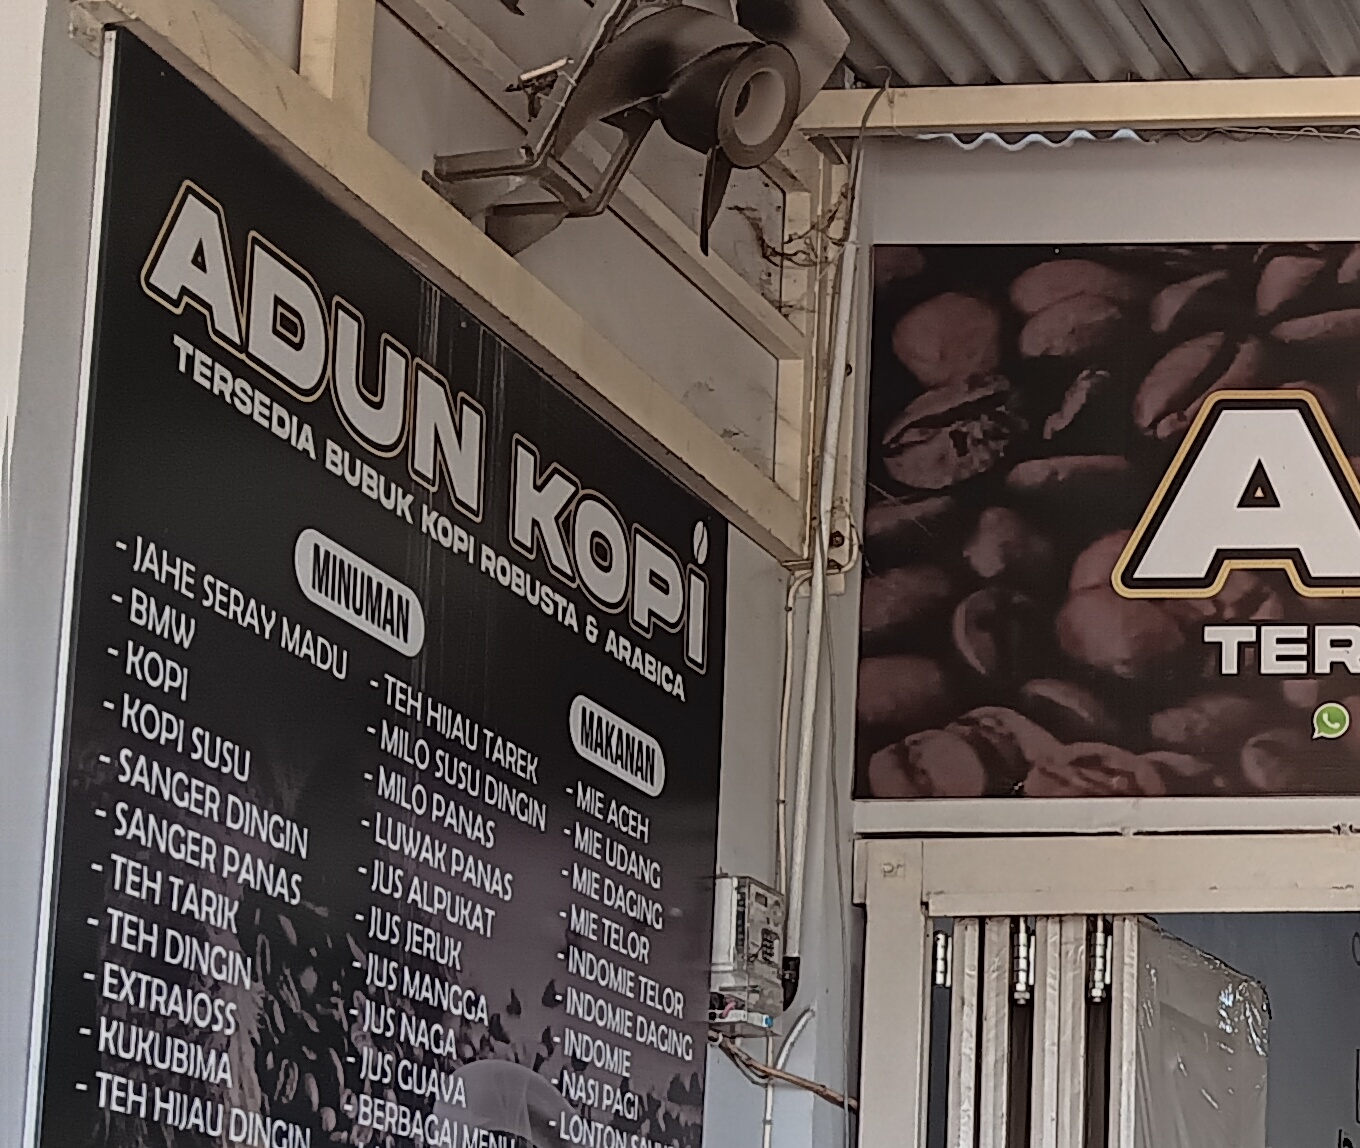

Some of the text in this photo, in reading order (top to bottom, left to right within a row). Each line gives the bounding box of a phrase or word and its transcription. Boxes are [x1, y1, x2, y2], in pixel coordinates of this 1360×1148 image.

[143, 183, 484, 519] ADUN
[172, 334, 686, 702] TERSEDIA BUBUK KOPI ROBUSTA & ARABICA
[129, 587, 196, 650] BMW
[133, 535, 348, 680] JAHE SERAY MADU
[311, 542, 412, 647] MINUMAN
[125, 639, 189, 702] KOPI
[121, 692, 251, 782] KOPI SUSU
[383, 672, 539, 785] TEH HIJAU TAREK
[580, 704, 656, 788] MAKANAN
[117, 747, 309, 860] SANGER DINGIN
[377, 764, 496, 849] MILO PANAS
[380, 718, 547, 832] MILO SUSU DINGIN
[575, 780, 649, 844] MIE ACEH
[113, 800, 303, 906] SANGER PANAS
[374, 811, 513, 901] LUWAK PANAS
[573, 821, 662, 890] MIE UDANG
[110, 852, 240, 934] TEH TARIK
[371, 858, 496, 938] JUS ALPUKAT
[571, 862, 664, 931] MIE DAGING
[106, 906, 252, 991] TEH DINGIN
[368, 905, 463, 971] JUS JERUK
[569, 903, 650, 965] MIE TELOR
[102, 961, 237, 1036] EXTRAJOSS
[365, 952, 489, 1027] JUS MANGGA
[567, 944, 685, 1020] INDOMIE TELOR
[98, 1015, 233, 1088] KUKUBIMA
[362, 998, 457, 1061] JUS NAGA
[563, 1027, 632, 1078] INDOMIE
[565, 986, 693, 1062] INDOMIE DAGING
[95, 1070, 147, 1119] TEH
[153, 1086, 224, 1138] HIJAU
[359, 1046, 467, 1109] JUS GUAVA
[561, 1069, 639, 1122] NASI PAGI
